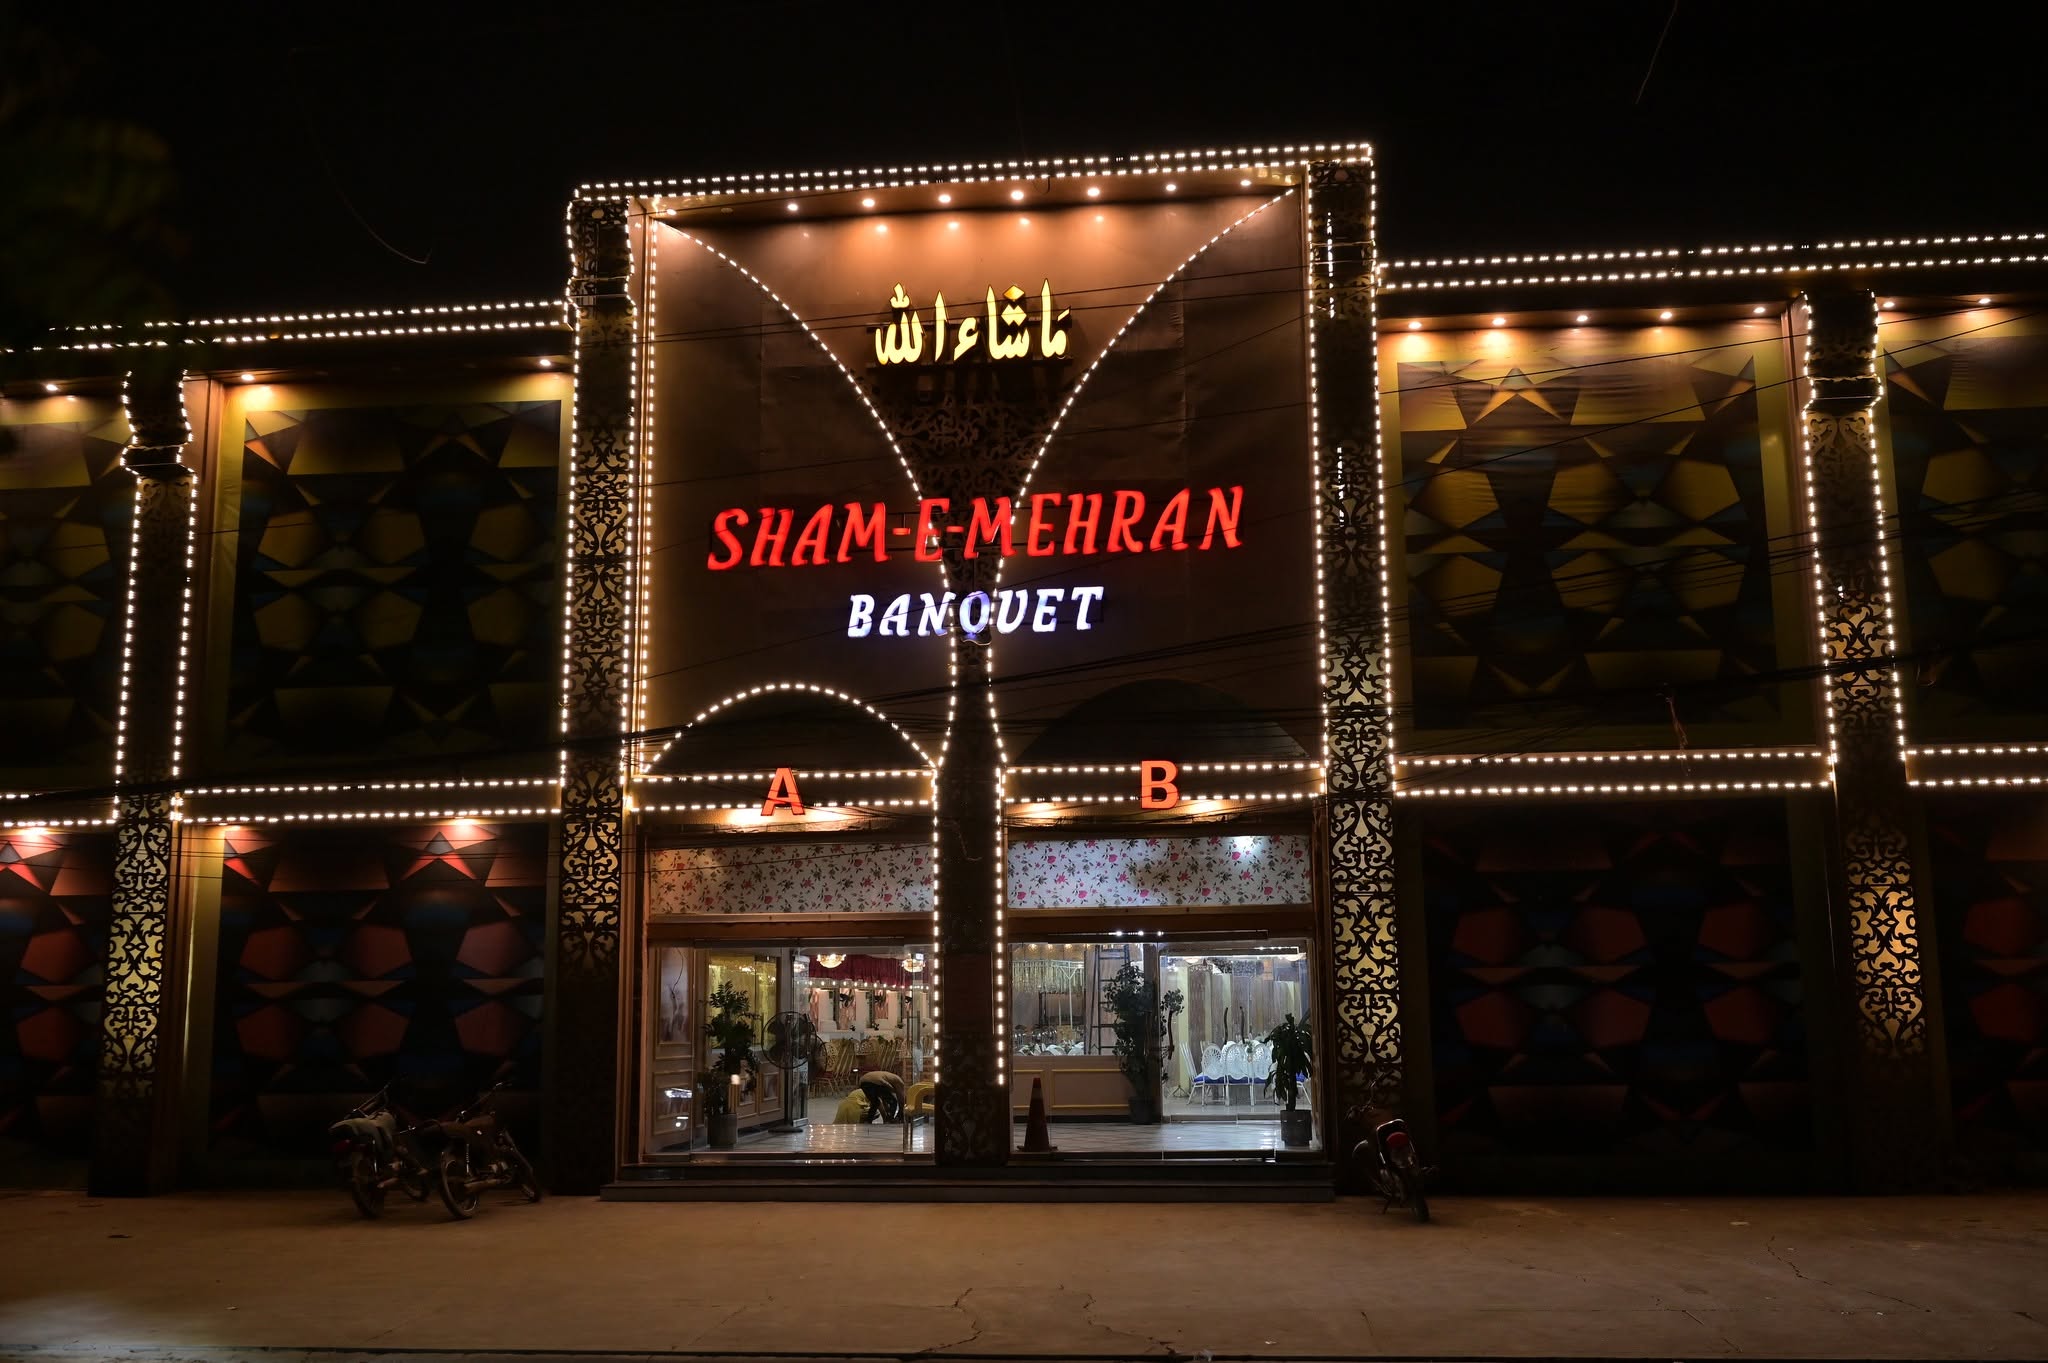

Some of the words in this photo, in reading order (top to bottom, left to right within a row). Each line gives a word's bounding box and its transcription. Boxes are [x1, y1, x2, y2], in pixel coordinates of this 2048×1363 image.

[707, 485, 1244, 571] SHAM-E-MEHRAN
[847, 586, 1104, 645] BANQUET
[760, 767, 805, 816] A
[1140, 760, 1179, 810] B
